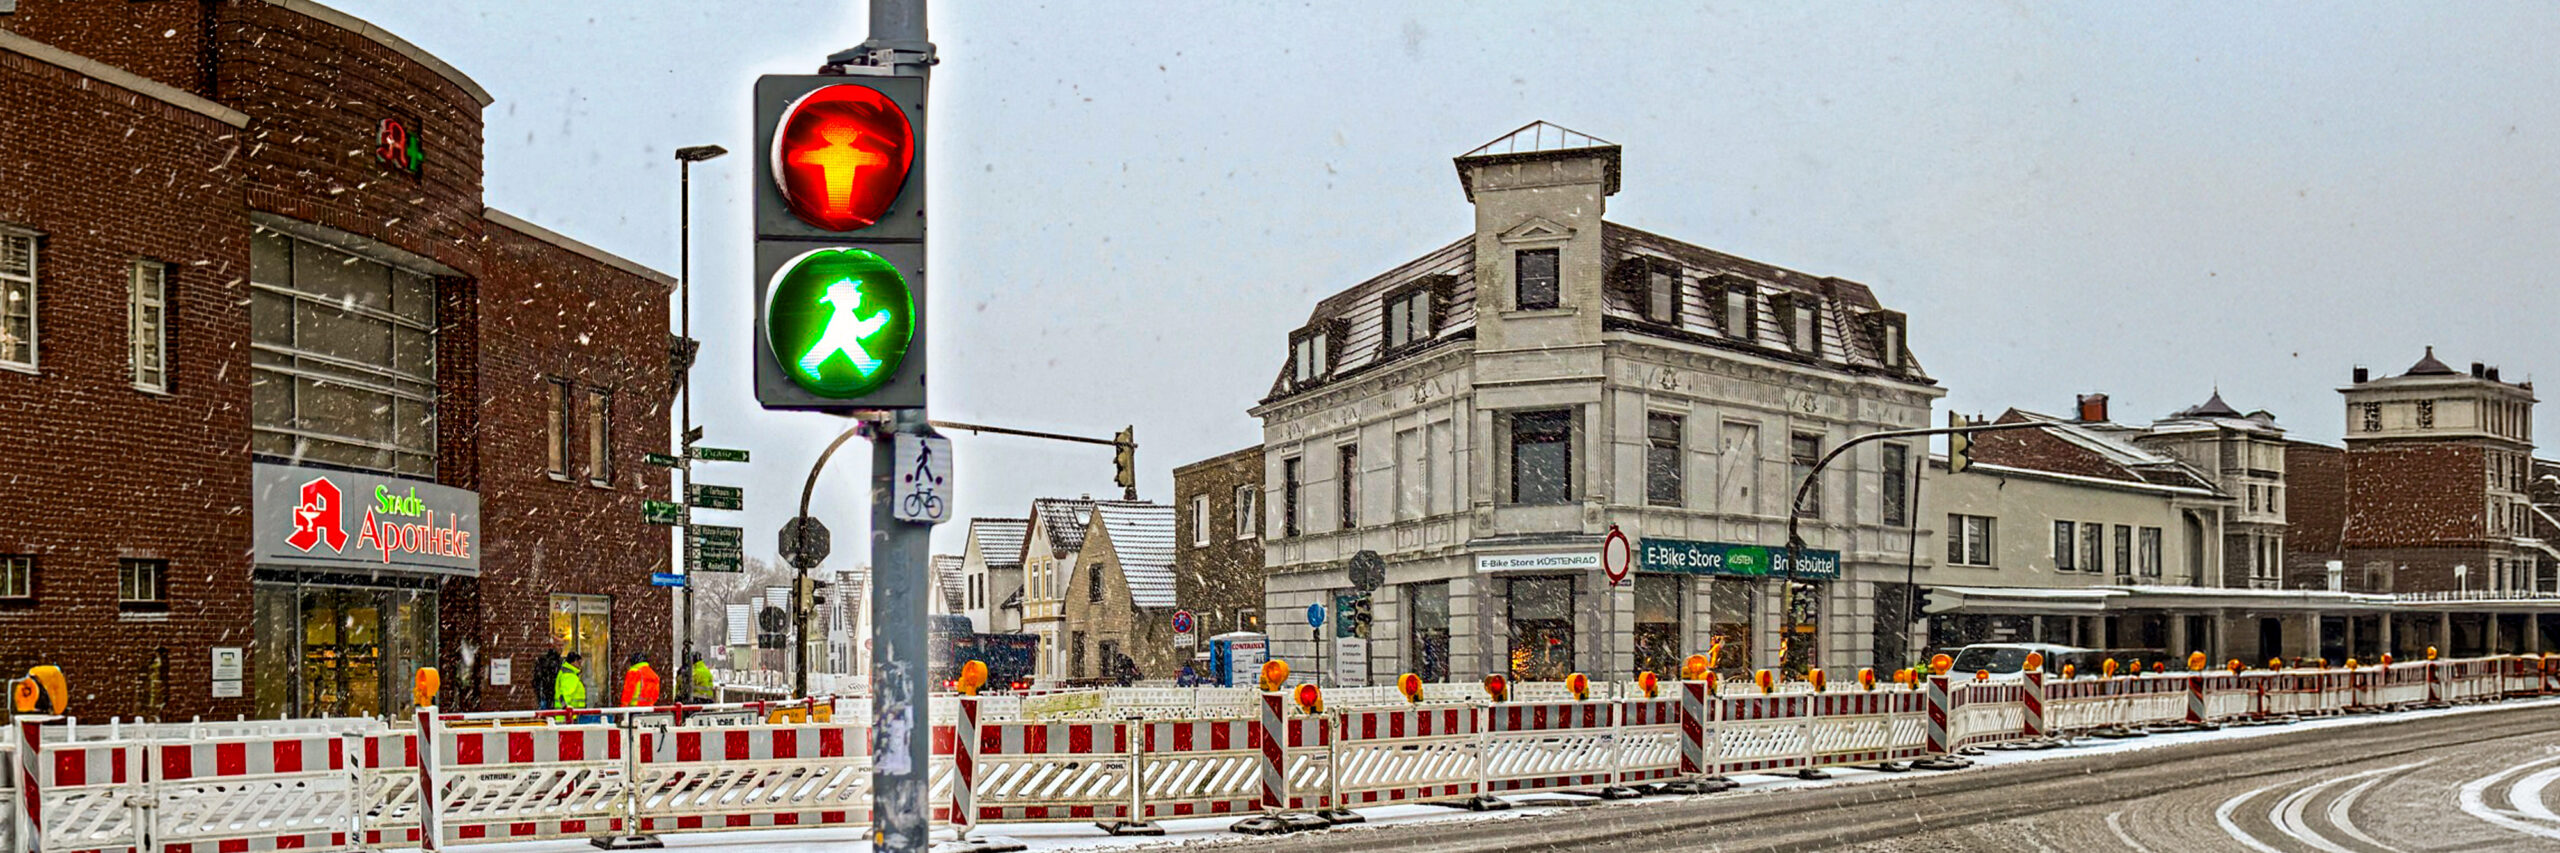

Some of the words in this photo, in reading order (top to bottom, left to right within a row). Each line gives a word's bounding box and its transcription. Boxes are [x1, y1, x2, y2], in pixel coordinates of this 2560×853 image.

[1481, 559, 1508, 567] E-Bike
[1510, 558, 1534, 567] Store
[1536, 556, 1597, 565] KÜSTENRAD
[1647, 547, 1685, 566] E-Bike
[1688, 549, 1721, 567] Store
